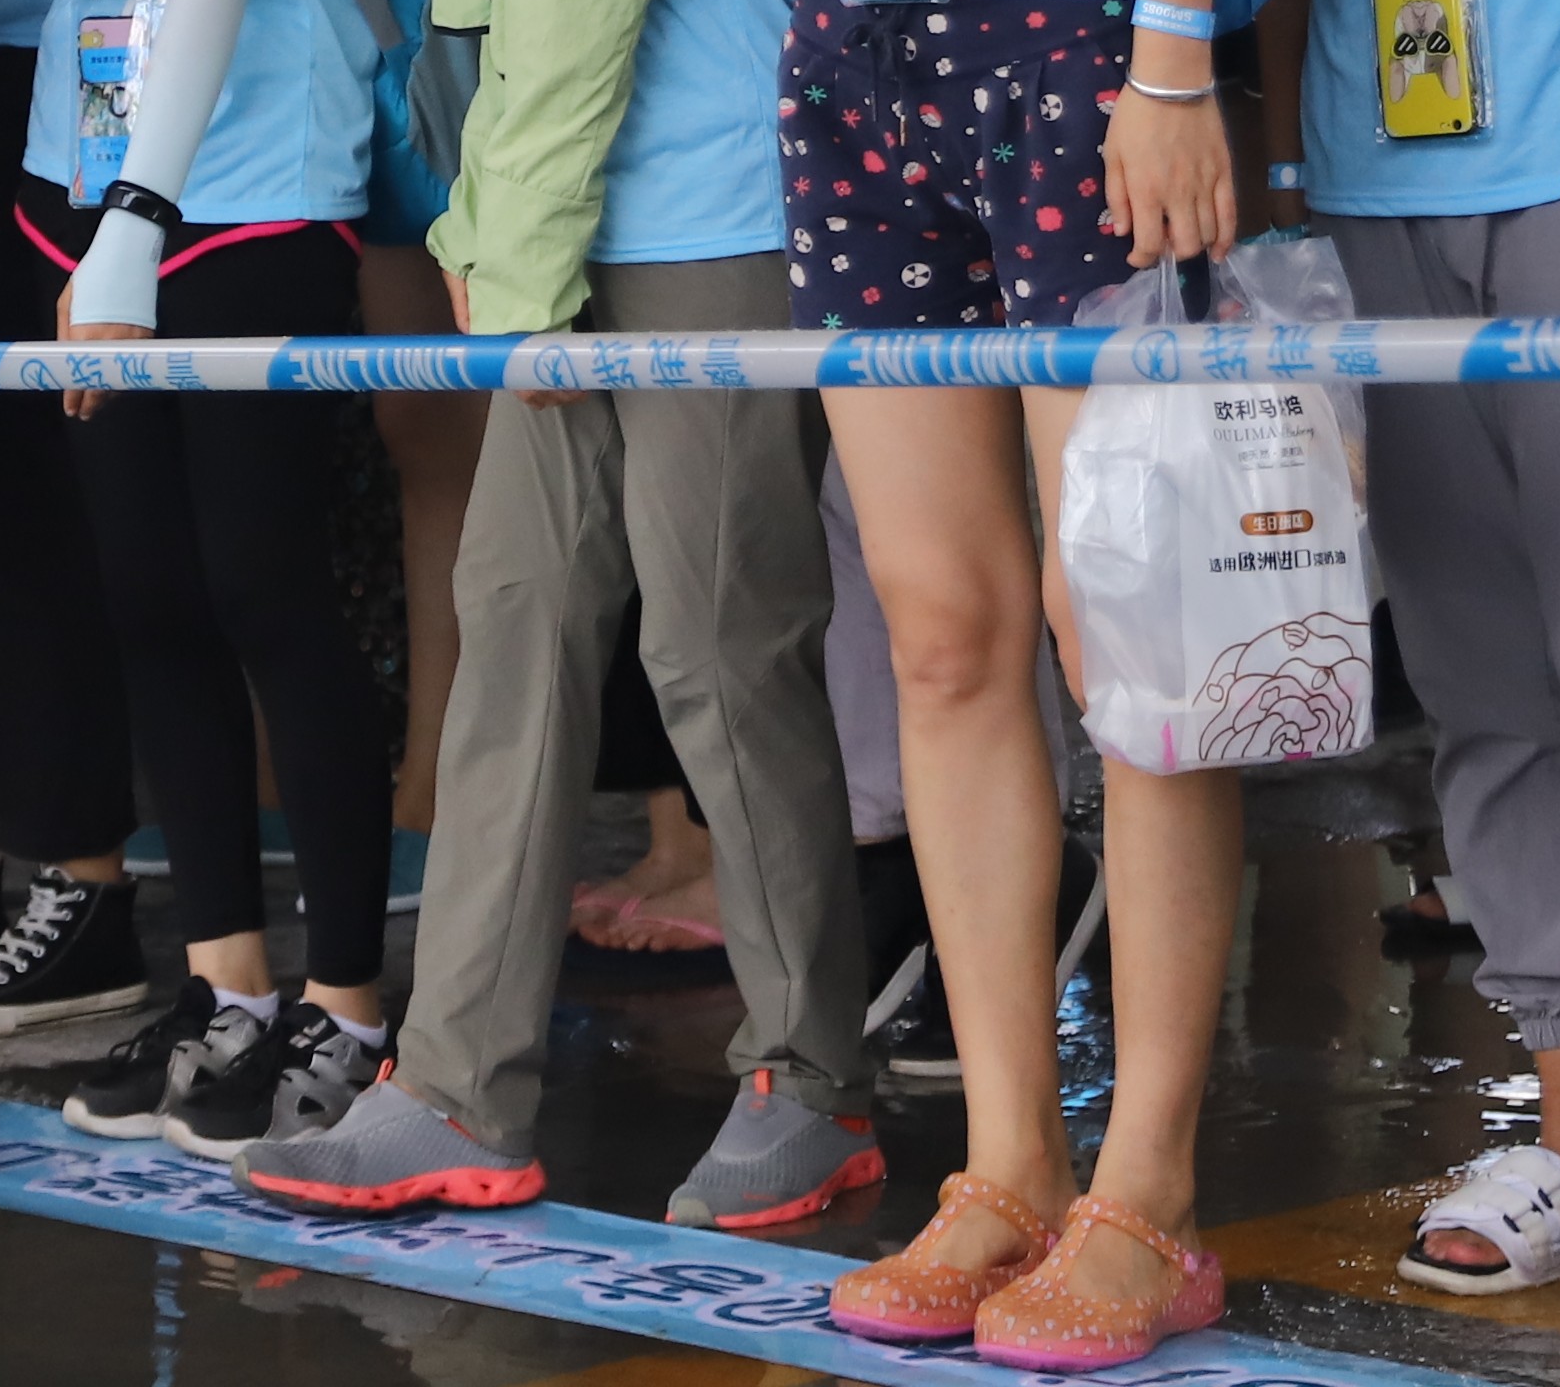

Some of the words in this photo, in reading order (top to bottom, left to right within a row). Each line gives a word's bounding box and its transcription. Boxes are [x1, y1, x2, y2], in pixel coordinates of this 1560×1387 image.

[1213, 425, 1277, 442] OULIMA
[1252, 512, 1305, 532] 生日蛋糕
